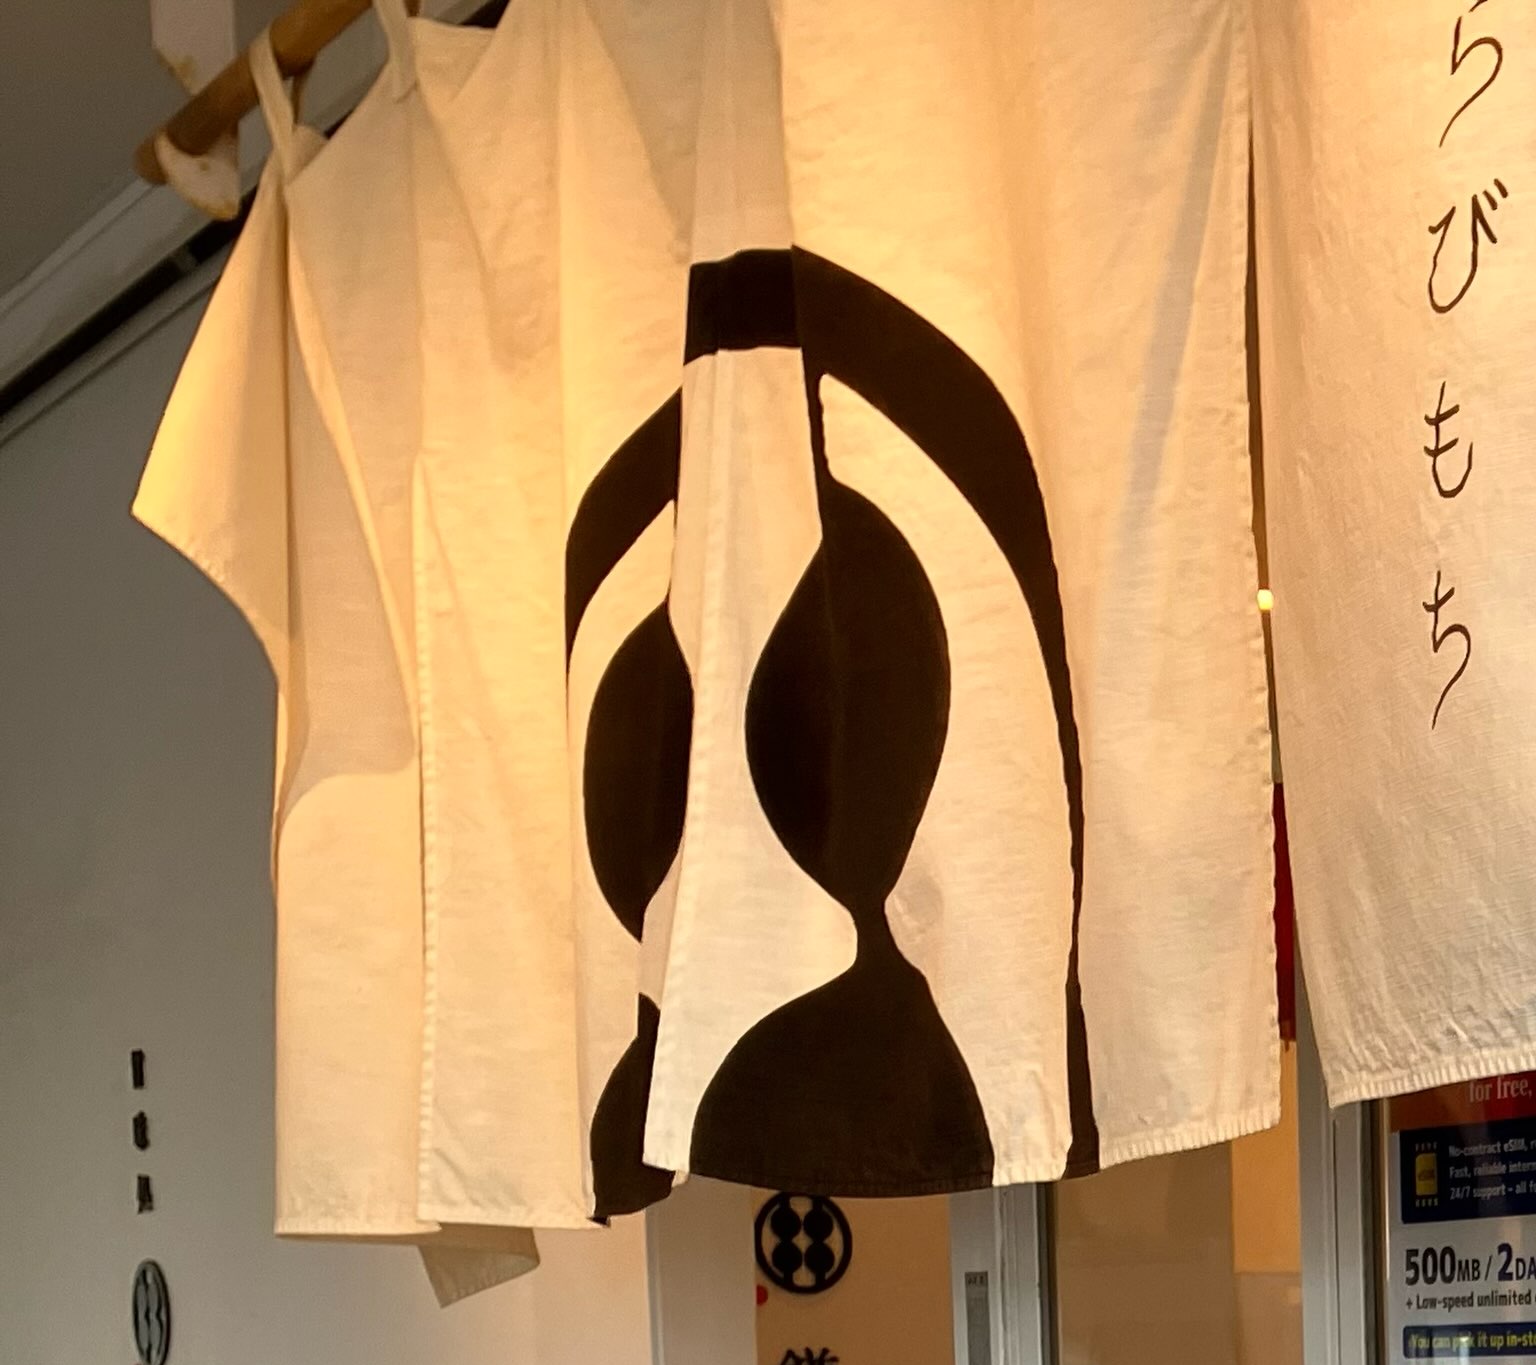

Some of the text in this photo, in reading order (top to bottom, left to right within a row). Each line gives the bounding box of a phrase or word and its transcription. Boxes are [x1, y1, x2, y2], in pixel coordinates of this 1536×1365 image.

[1497, 1074, 1533, 1101] free,
[1473, 1182, 1506, 1201] support
[1515, 1180, 1528, 1195] all
[1405, 1246, 1480, 1287] 500MB
[1416, 1294, 1474, 1314] Low-speed
[1477, 1292, 1532, 1307] unlimited
[1478, 1331, 1487, 1346] it
[1490, 1333, 1504, 1351] up
